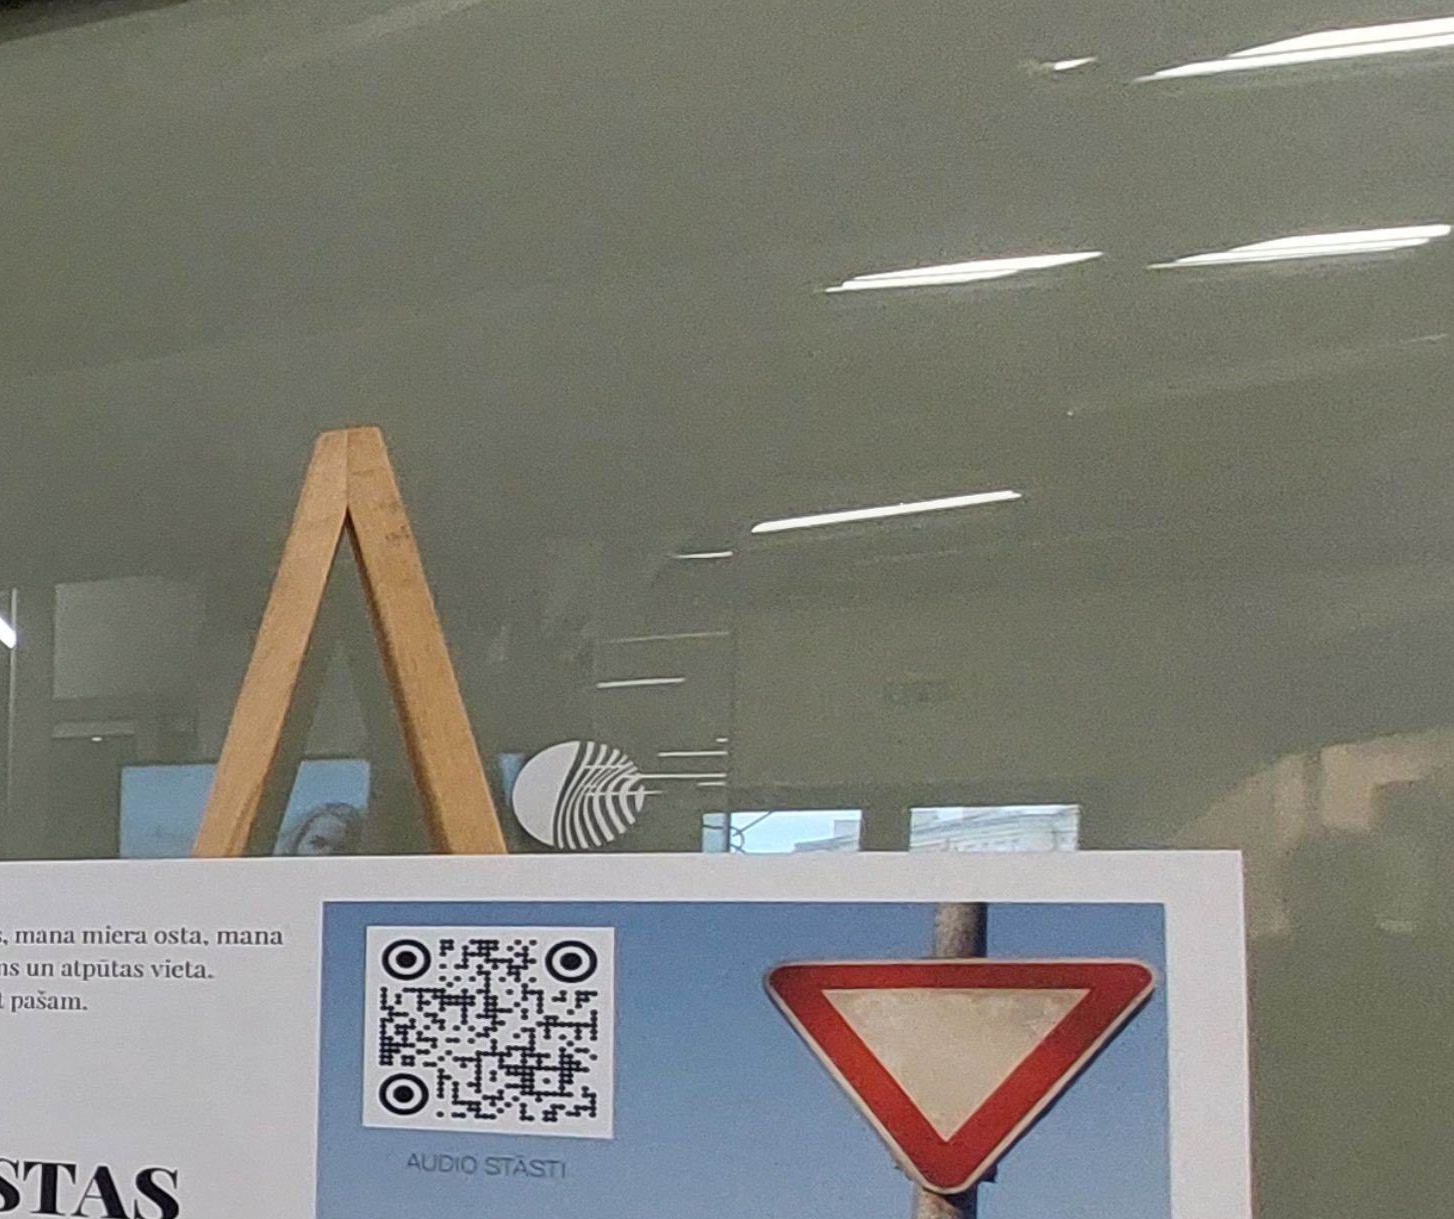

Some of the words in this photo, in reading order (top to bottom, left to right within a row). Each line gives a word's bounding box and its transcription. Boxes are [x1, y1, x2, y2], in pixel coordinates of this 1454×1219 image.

[15, 929, 75, 945] mana
[82, 925, 147, 945] miera
[154, 927, 209, 946] osta,
[217, 929, 283, 946] mana
[27, 961, 54, 977] un
[61, 959, 144, 981] atpūtas
[151, 960, 214, 979] vieta.
[11, 990, 88, 1013] pašam.
[406, 1153, 478, 1175] AUDIO
[485, 1155, 566, 1179] STĀSTI
